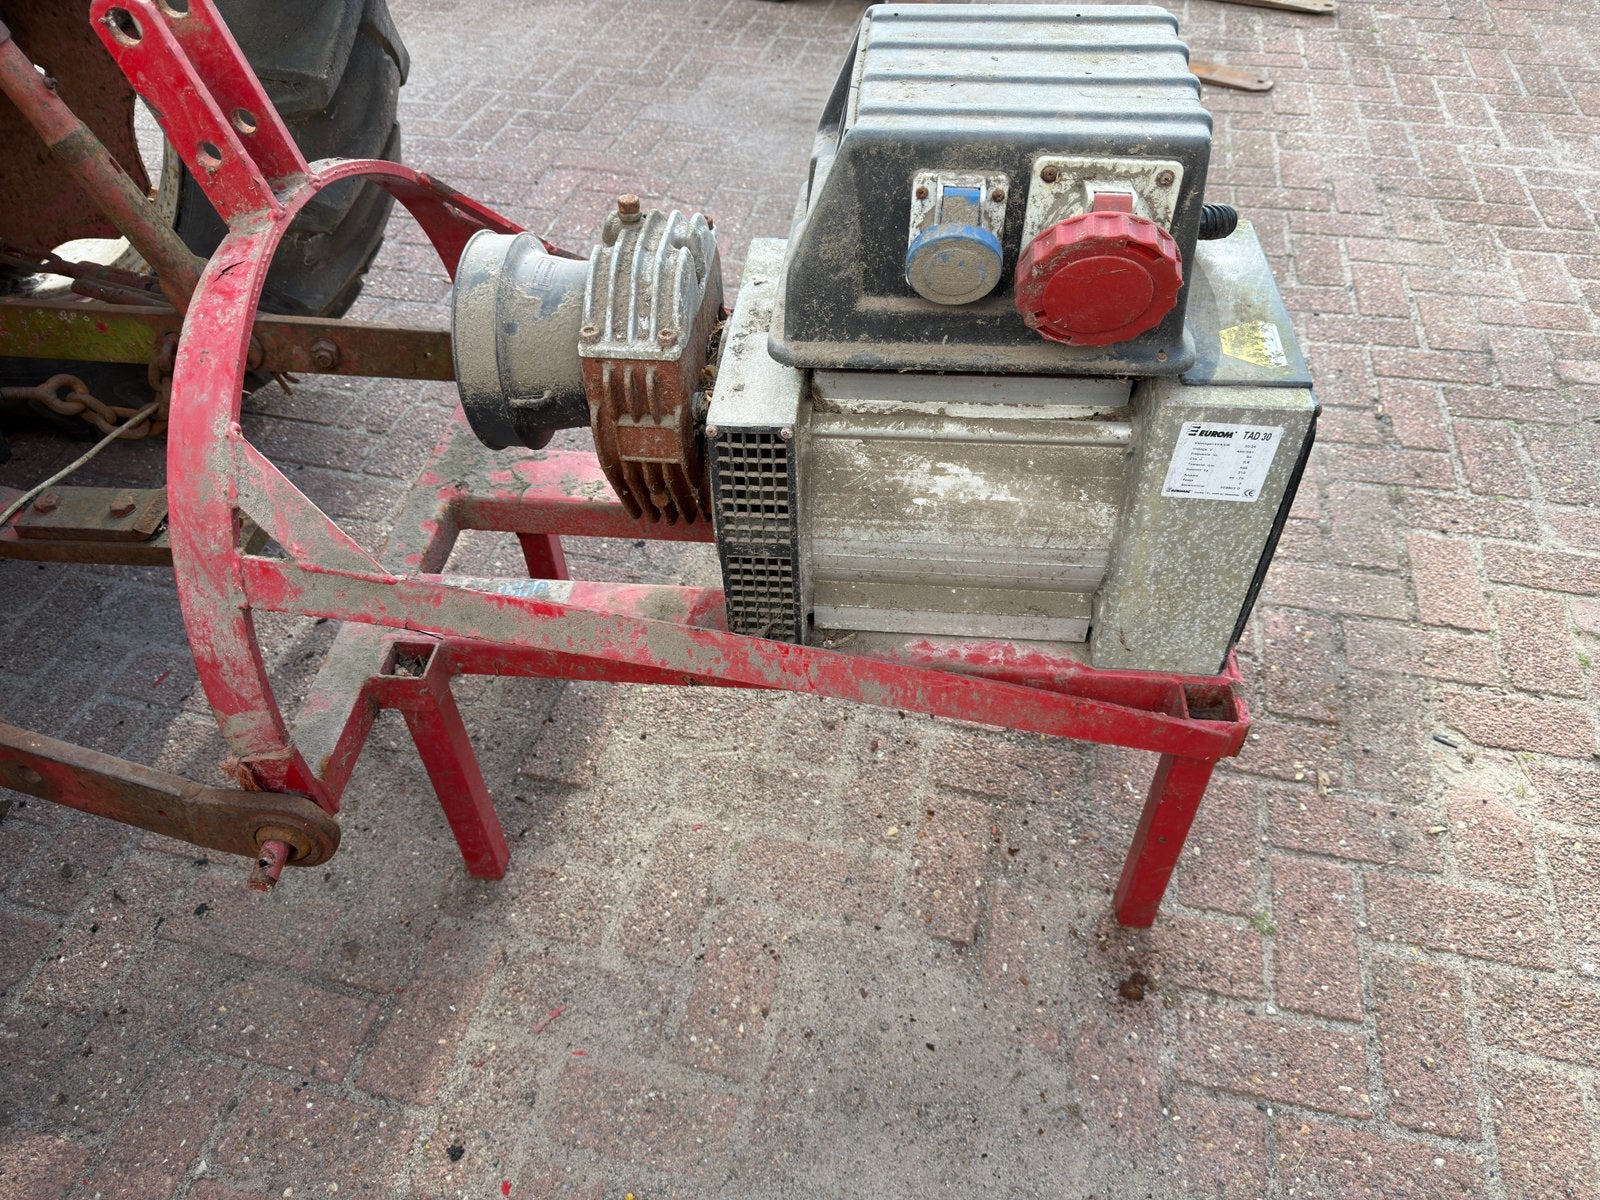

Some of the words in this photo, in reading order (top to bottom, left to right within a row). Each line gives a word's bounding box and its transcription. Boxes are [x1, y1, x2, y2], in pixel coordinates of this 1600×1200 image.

[1198, 430, 1234, 439] EUROM
[1243, 431, 1261, 441] TAD
[1261, 432, 1273, 441] 30
